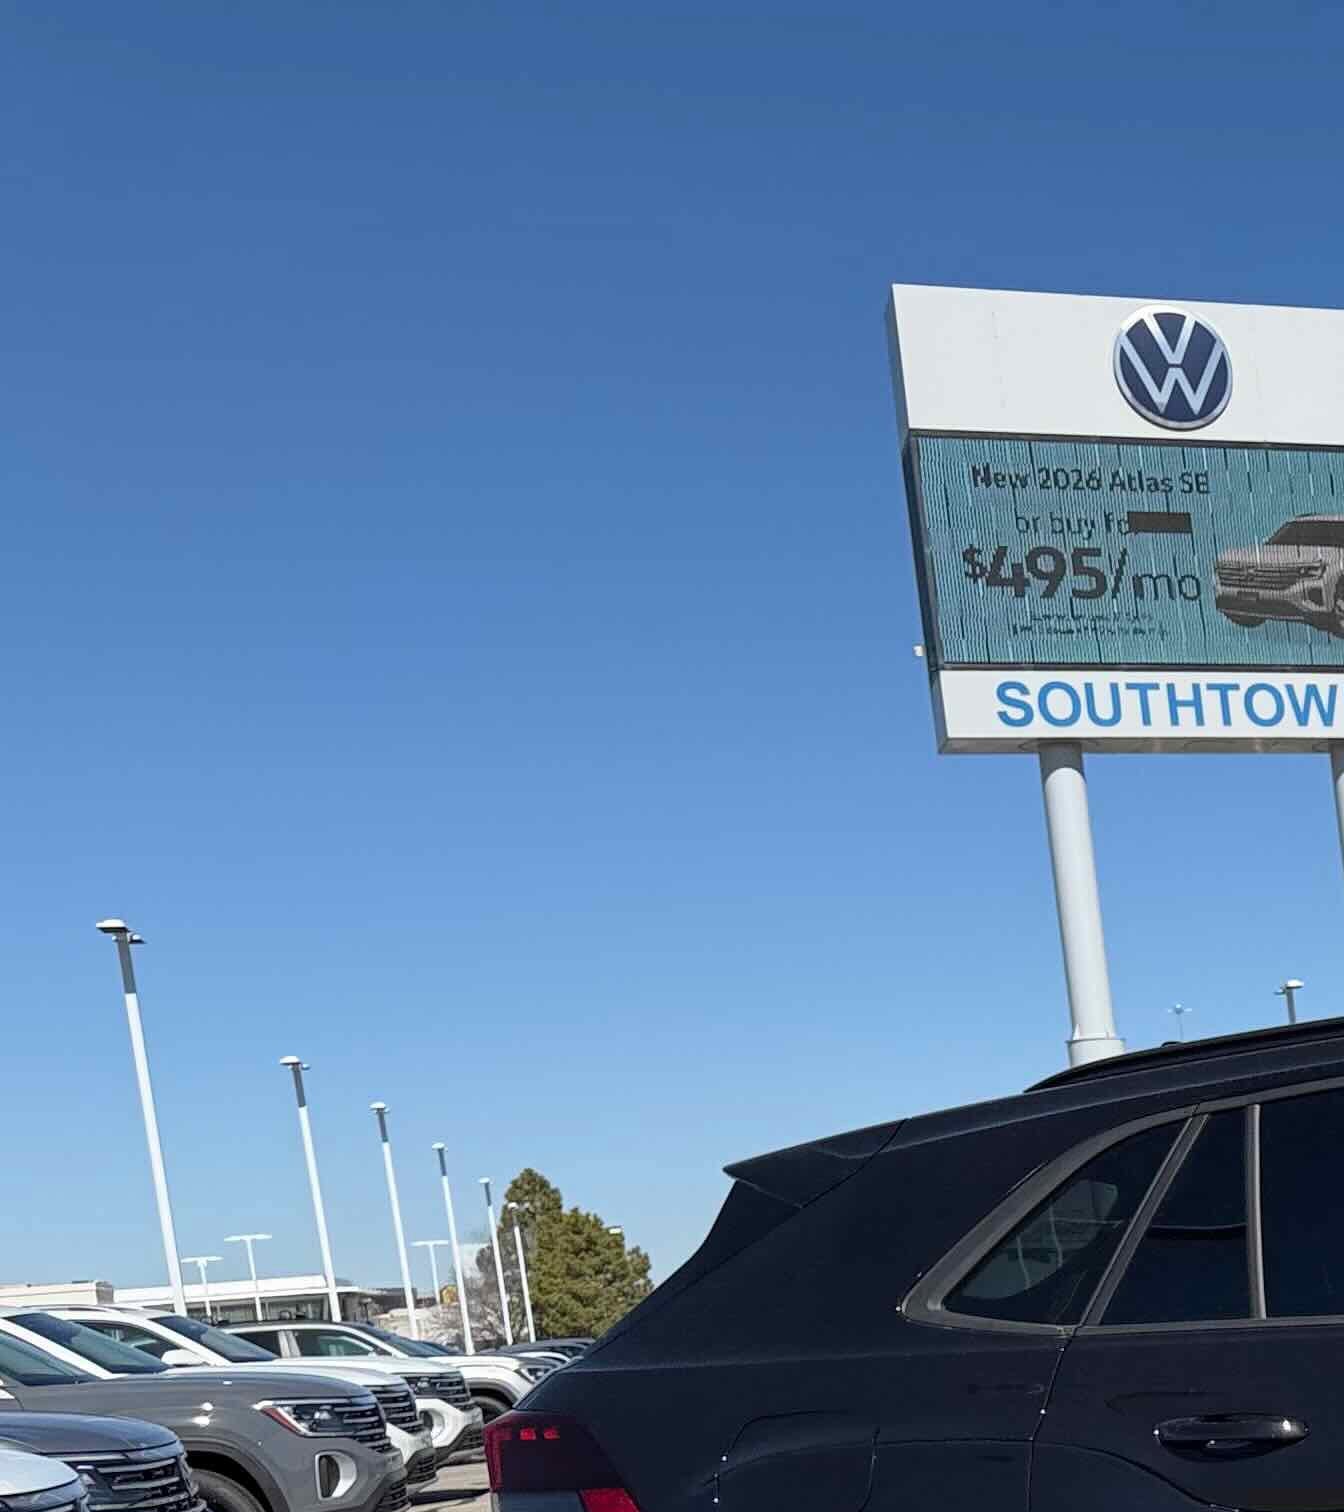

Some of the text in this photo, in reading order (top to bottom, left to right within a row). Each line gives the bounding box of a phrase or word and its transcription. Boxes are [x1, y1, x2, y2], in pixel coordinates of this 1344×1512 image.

[1115, 305, 1231, 427] VW
[971, 462, 1210, 494] New 2026 Atlas SE
[1015, 513, 1041, 534] or
[1050, 513, 1096, 541] buy
